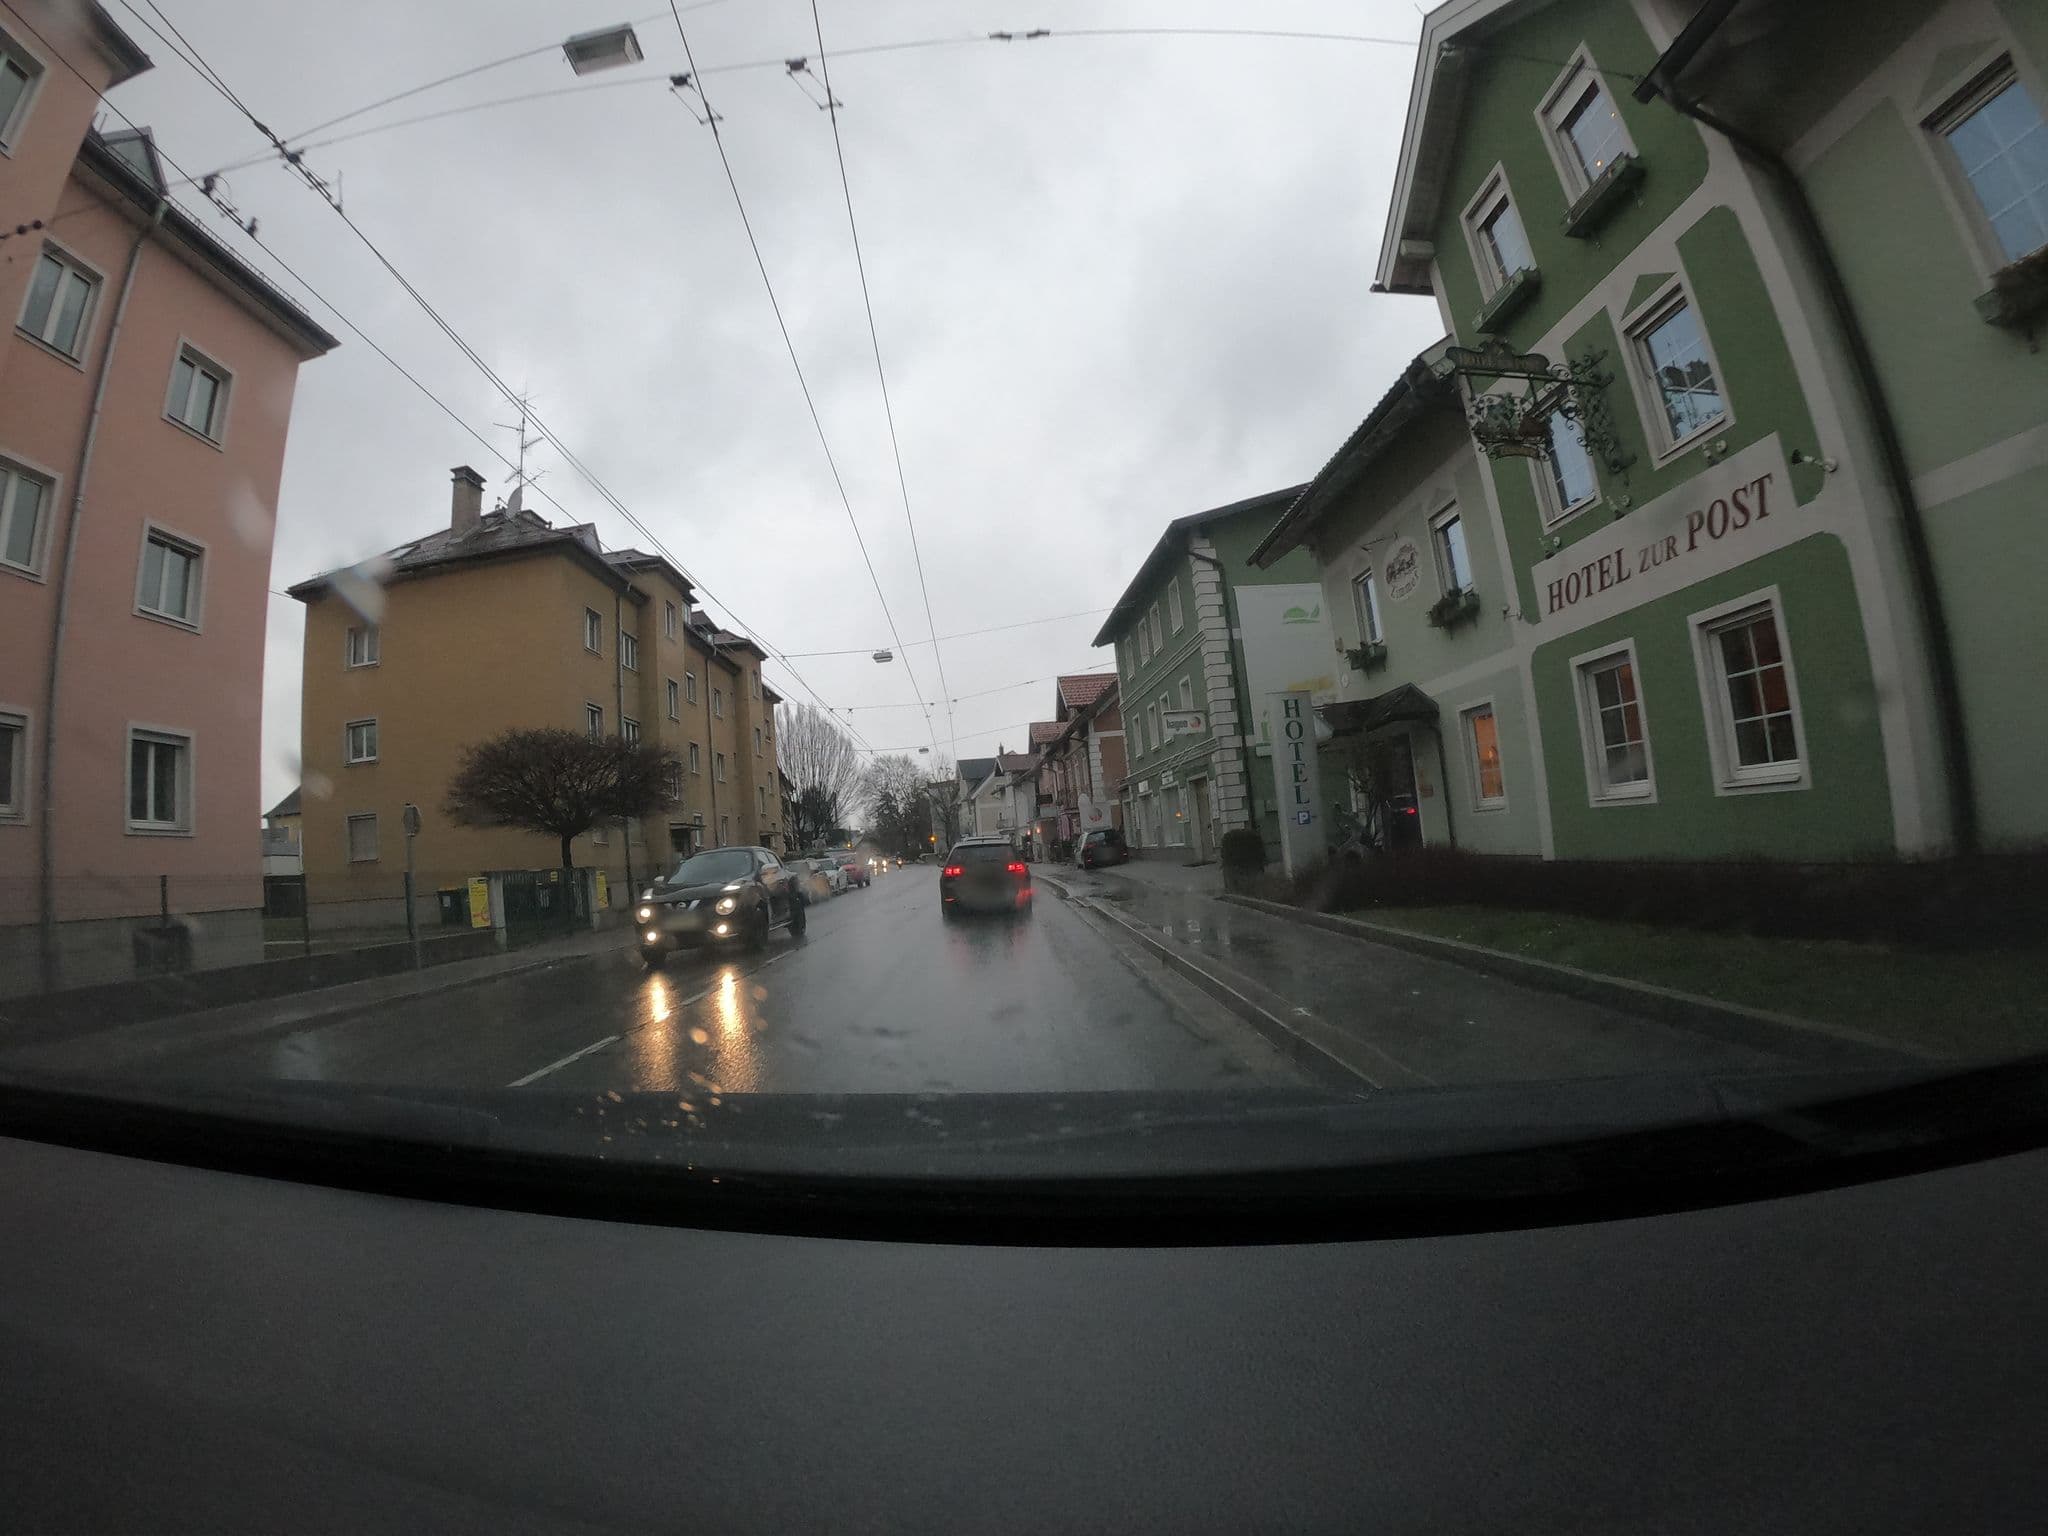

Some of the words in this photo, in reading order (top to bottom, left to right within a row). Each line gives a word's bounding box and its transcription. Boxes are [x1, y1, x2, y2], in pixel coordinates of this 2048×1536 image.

[1547, 548, 1631, 615] HOTEL
[1638, 534, 1679, 575] ZUR
[1686, 472, 1774, 553] POST
[1281, 698, 1310, 804] HOTEL
